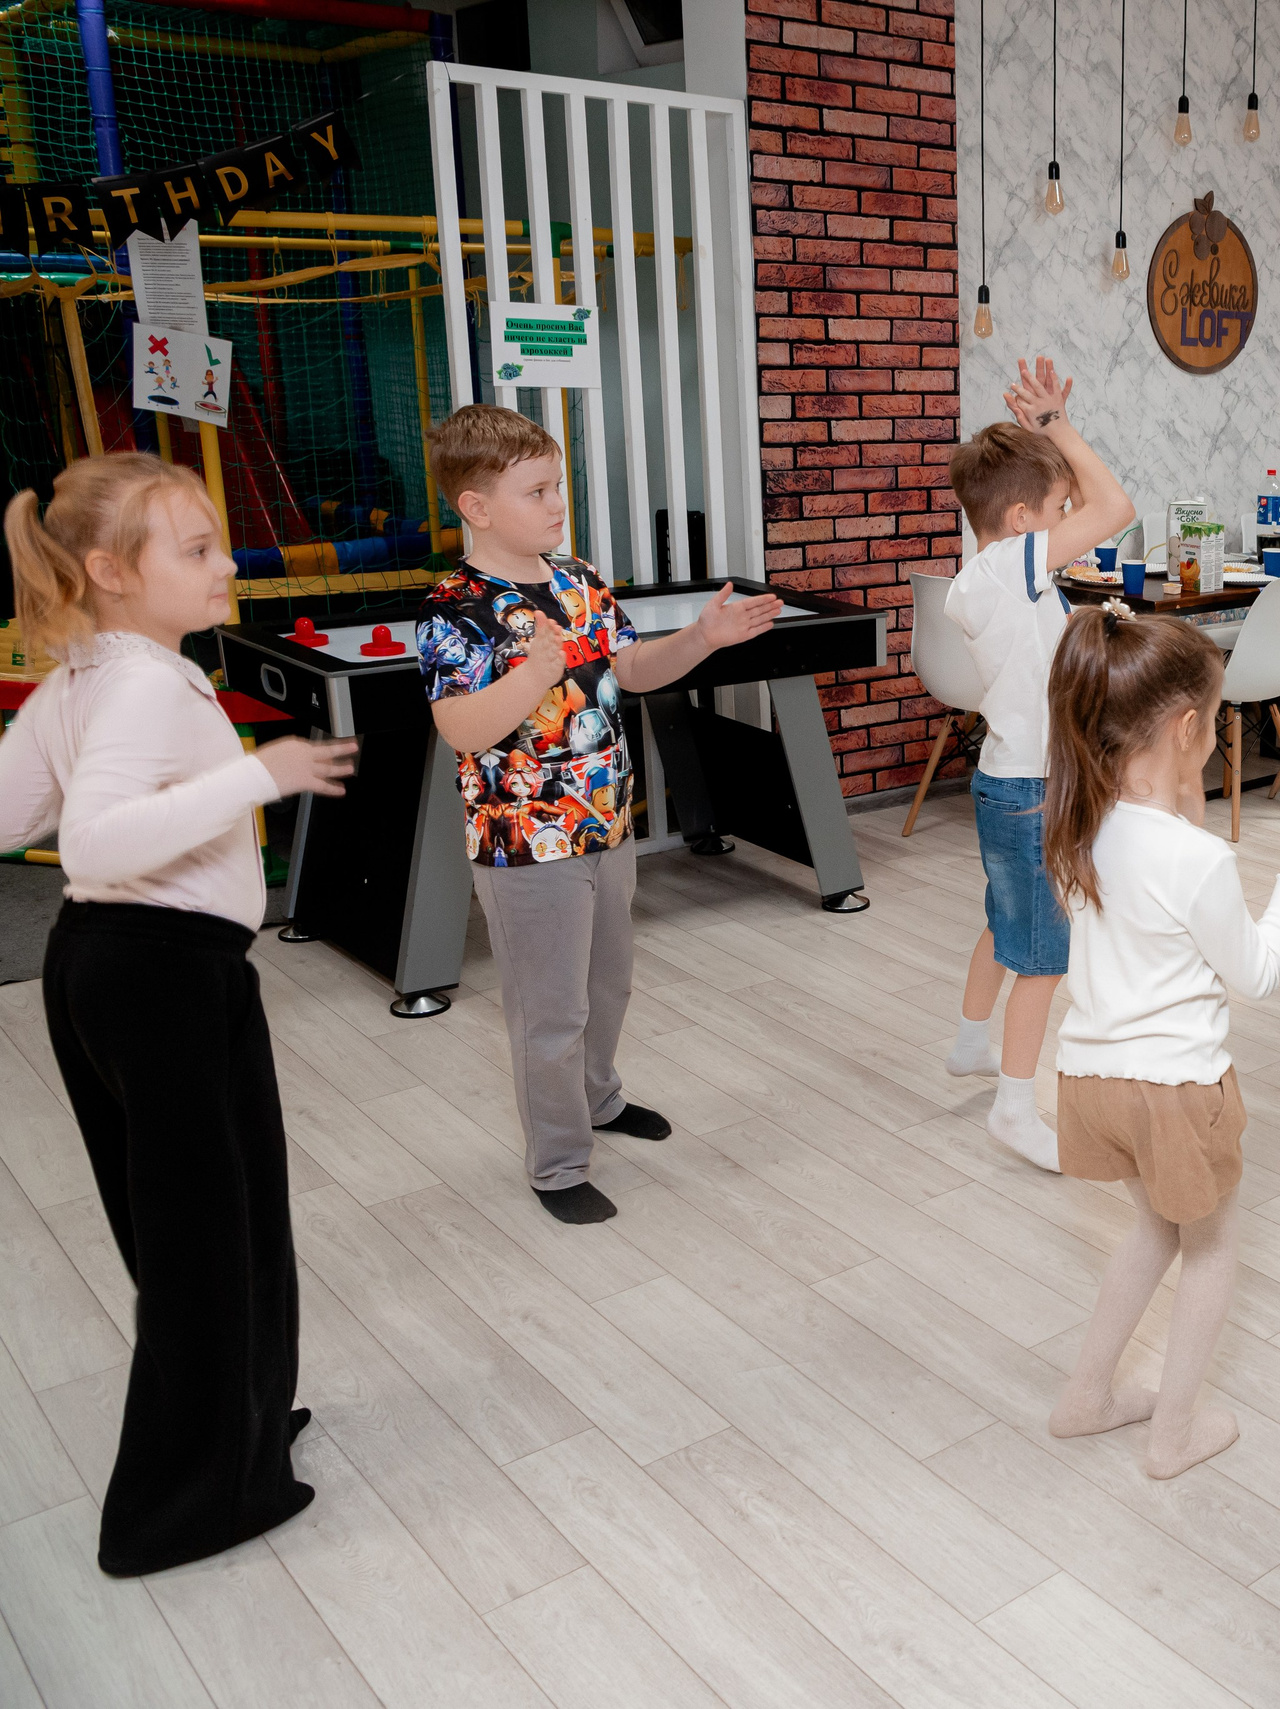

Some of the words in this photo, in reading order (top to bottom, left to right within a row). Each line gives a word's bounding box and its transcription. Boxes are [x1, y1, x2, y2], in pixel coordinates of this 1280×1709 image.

[0, 125, 340, 234] RTHDAY
[1161, 249, 1249, 317] Ежевика
[506, 320, 534, 330] Очень
[536, 322, 566, 331] просим
[1180, 308, 1253, 349] LOFT
[504, 334, 534, 343] ничего
[548, 336, 576, 344] класть
[520, 346, 568, 356] аэрохоккей
[1174, 507, 1203, 517] Вкусно
